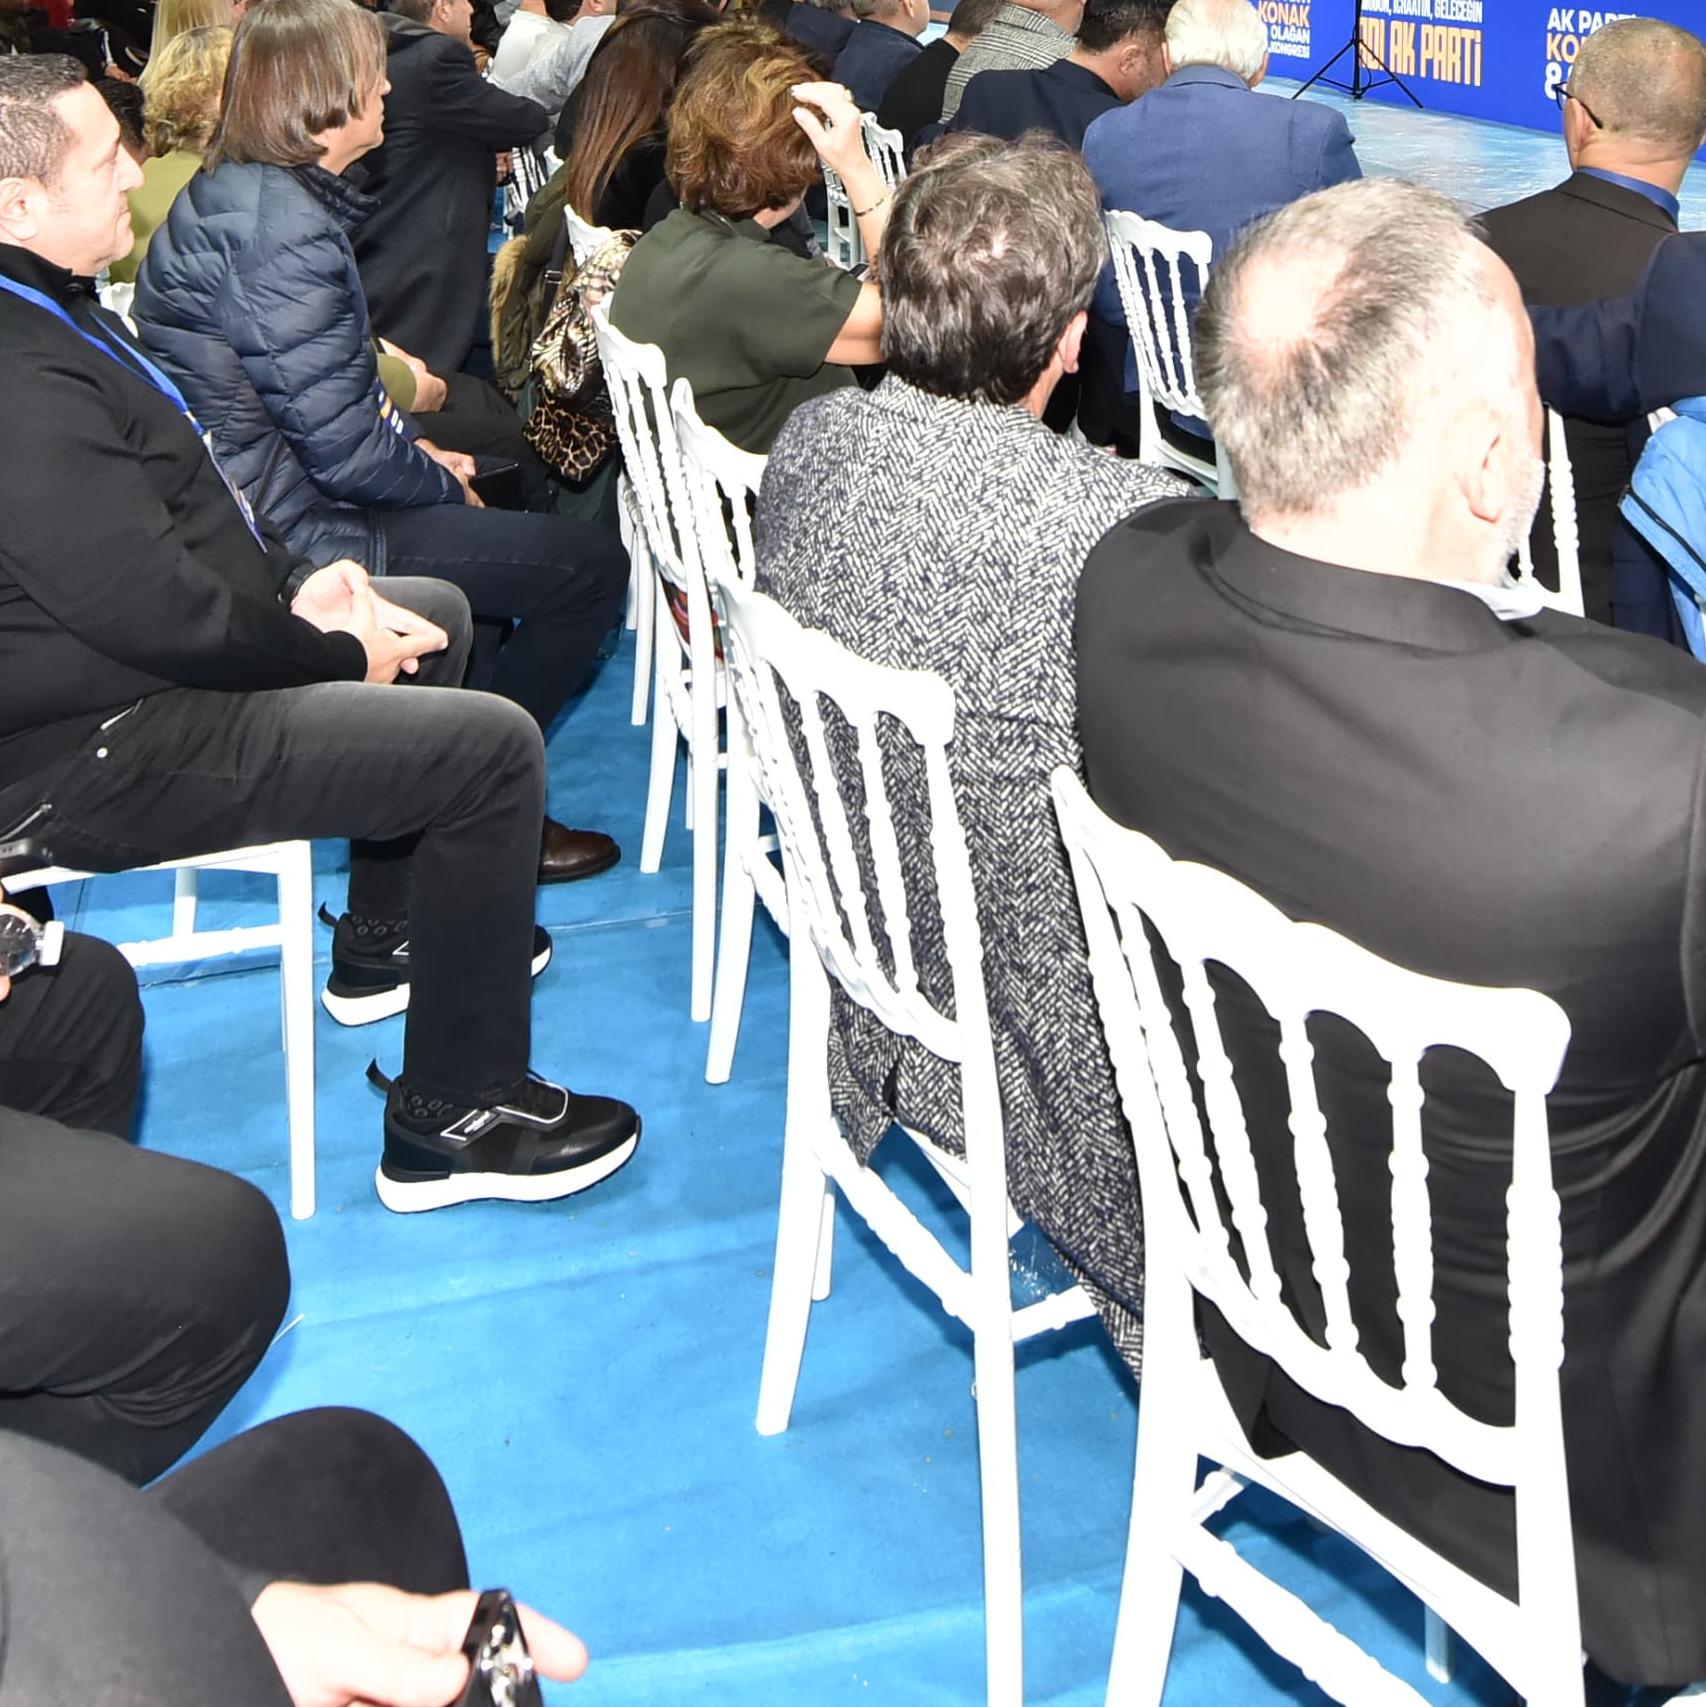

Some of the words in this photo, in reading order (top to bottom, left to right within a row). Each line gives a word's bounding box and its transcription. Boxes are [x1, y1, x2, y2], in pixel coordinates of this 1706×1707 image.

[1258, 1, 1310, 27] KONAK
[1547, 8, 1575, 32] AK
[1270, 24, 1310, 44] OLAĞAN
[1390, 20, 1416, 76] AK
